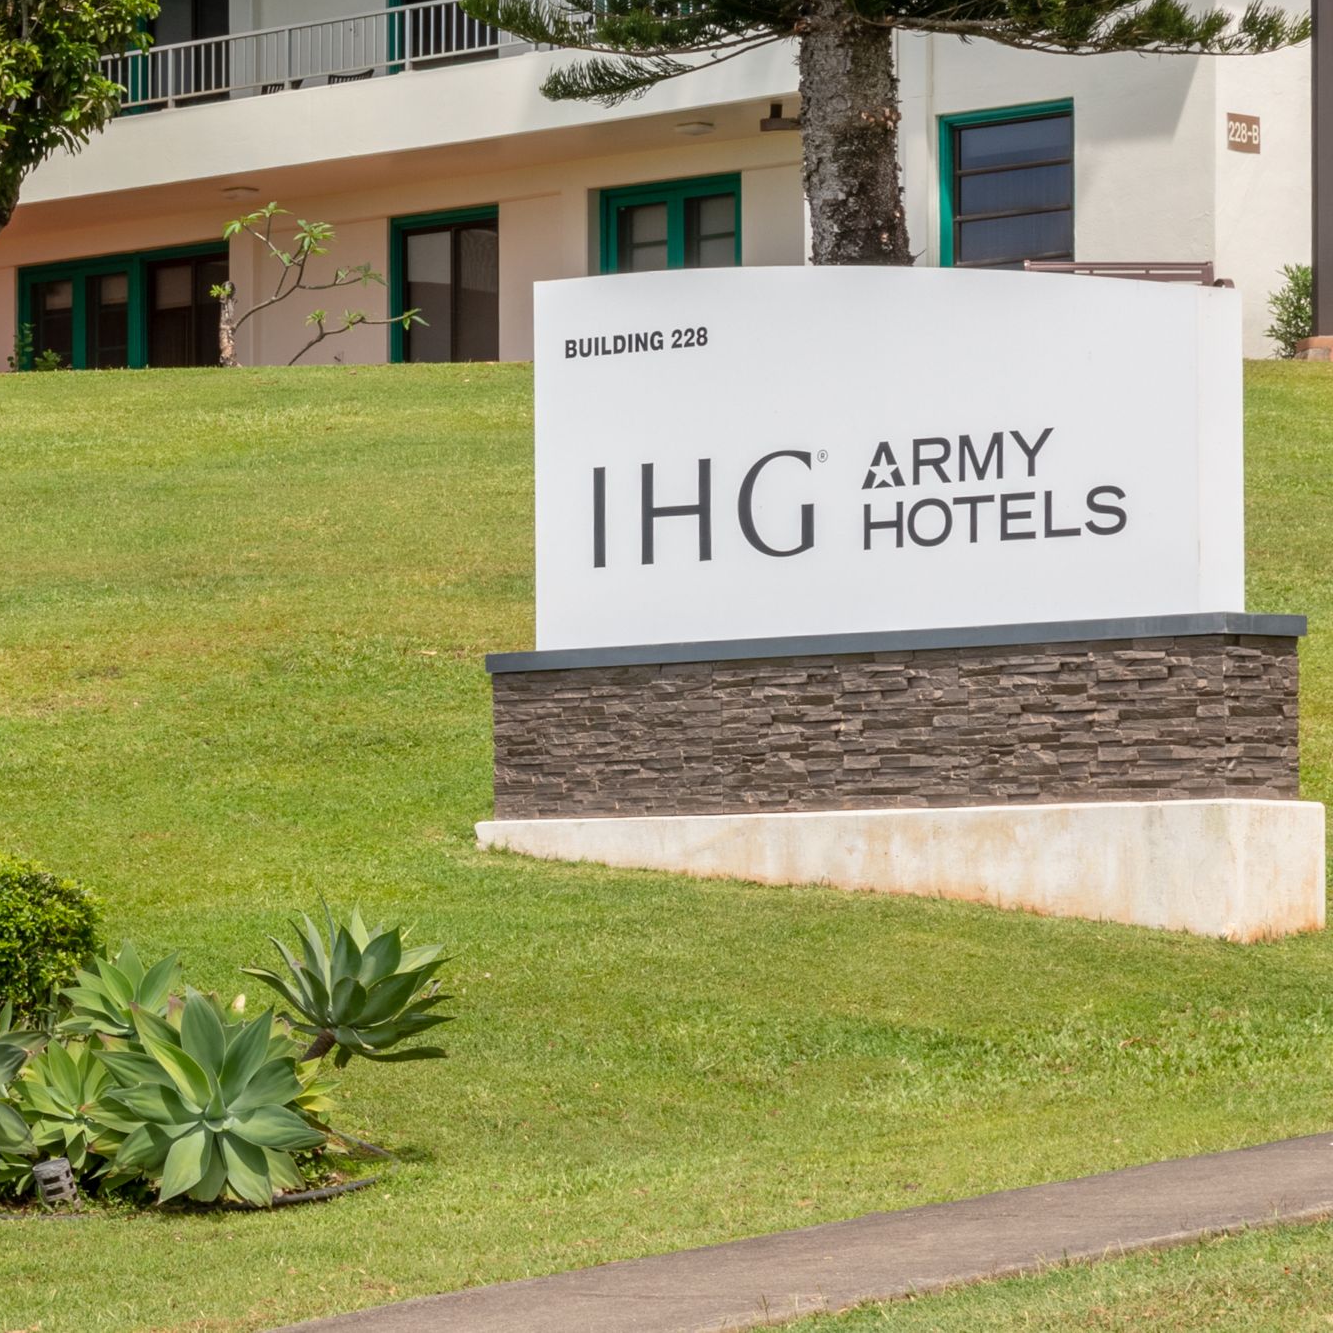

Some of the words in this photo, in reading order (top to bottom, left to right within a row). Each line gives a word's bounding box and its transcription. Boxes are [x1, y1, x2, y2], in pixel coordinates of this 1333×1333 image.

[1228, 121, 1259, 145] 228-B
[564, 330, 665, 359] BUILDING
[670, 326, 709, 350] 228
[861, 427, 1055, 490] ARMY
[593, 449, 816, 569] IHG
[862, 485, 1128, 551] HOTELS
